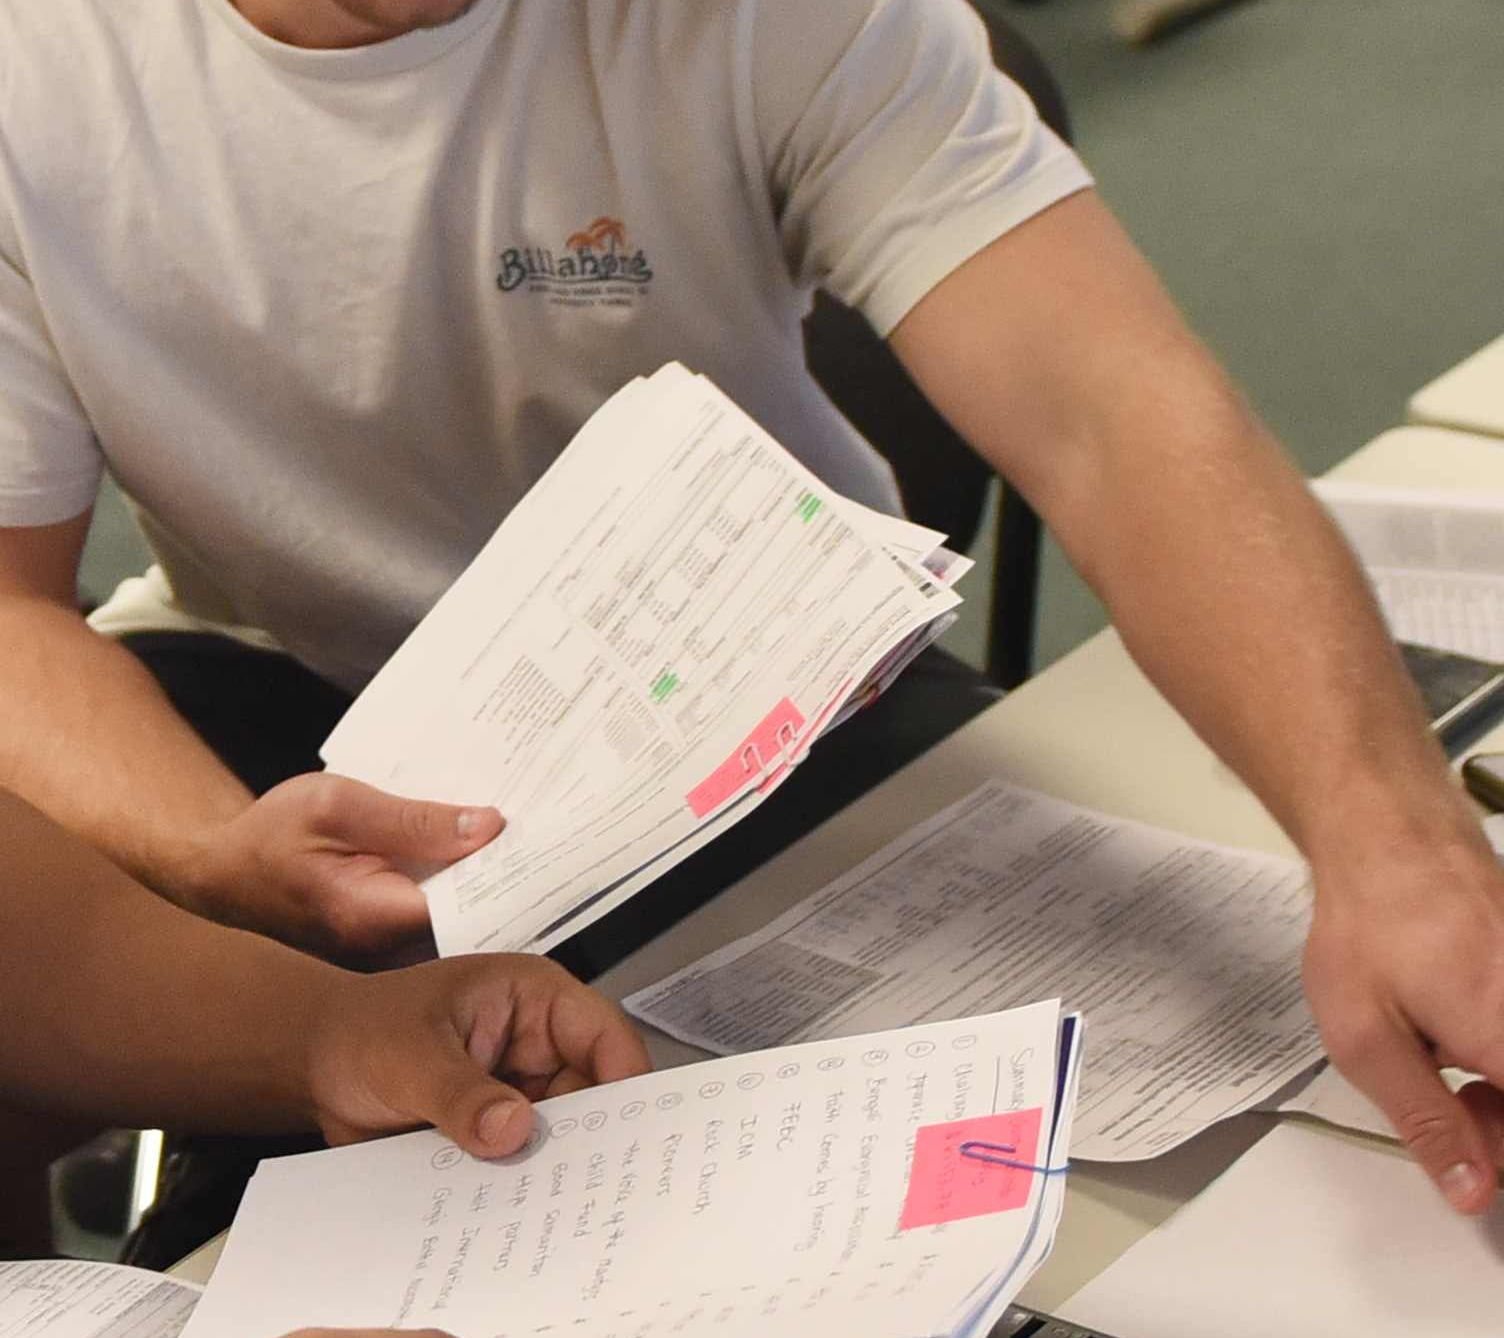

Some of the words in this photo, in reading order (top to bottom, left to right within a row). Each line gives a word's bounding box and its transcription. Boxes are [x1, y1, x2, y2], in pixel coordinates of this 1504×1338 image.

[703, 1120, 724, 1154] Rock
[736, 1115, 759, 1161] ICM
[691, 1162, 719, 1216] Church
